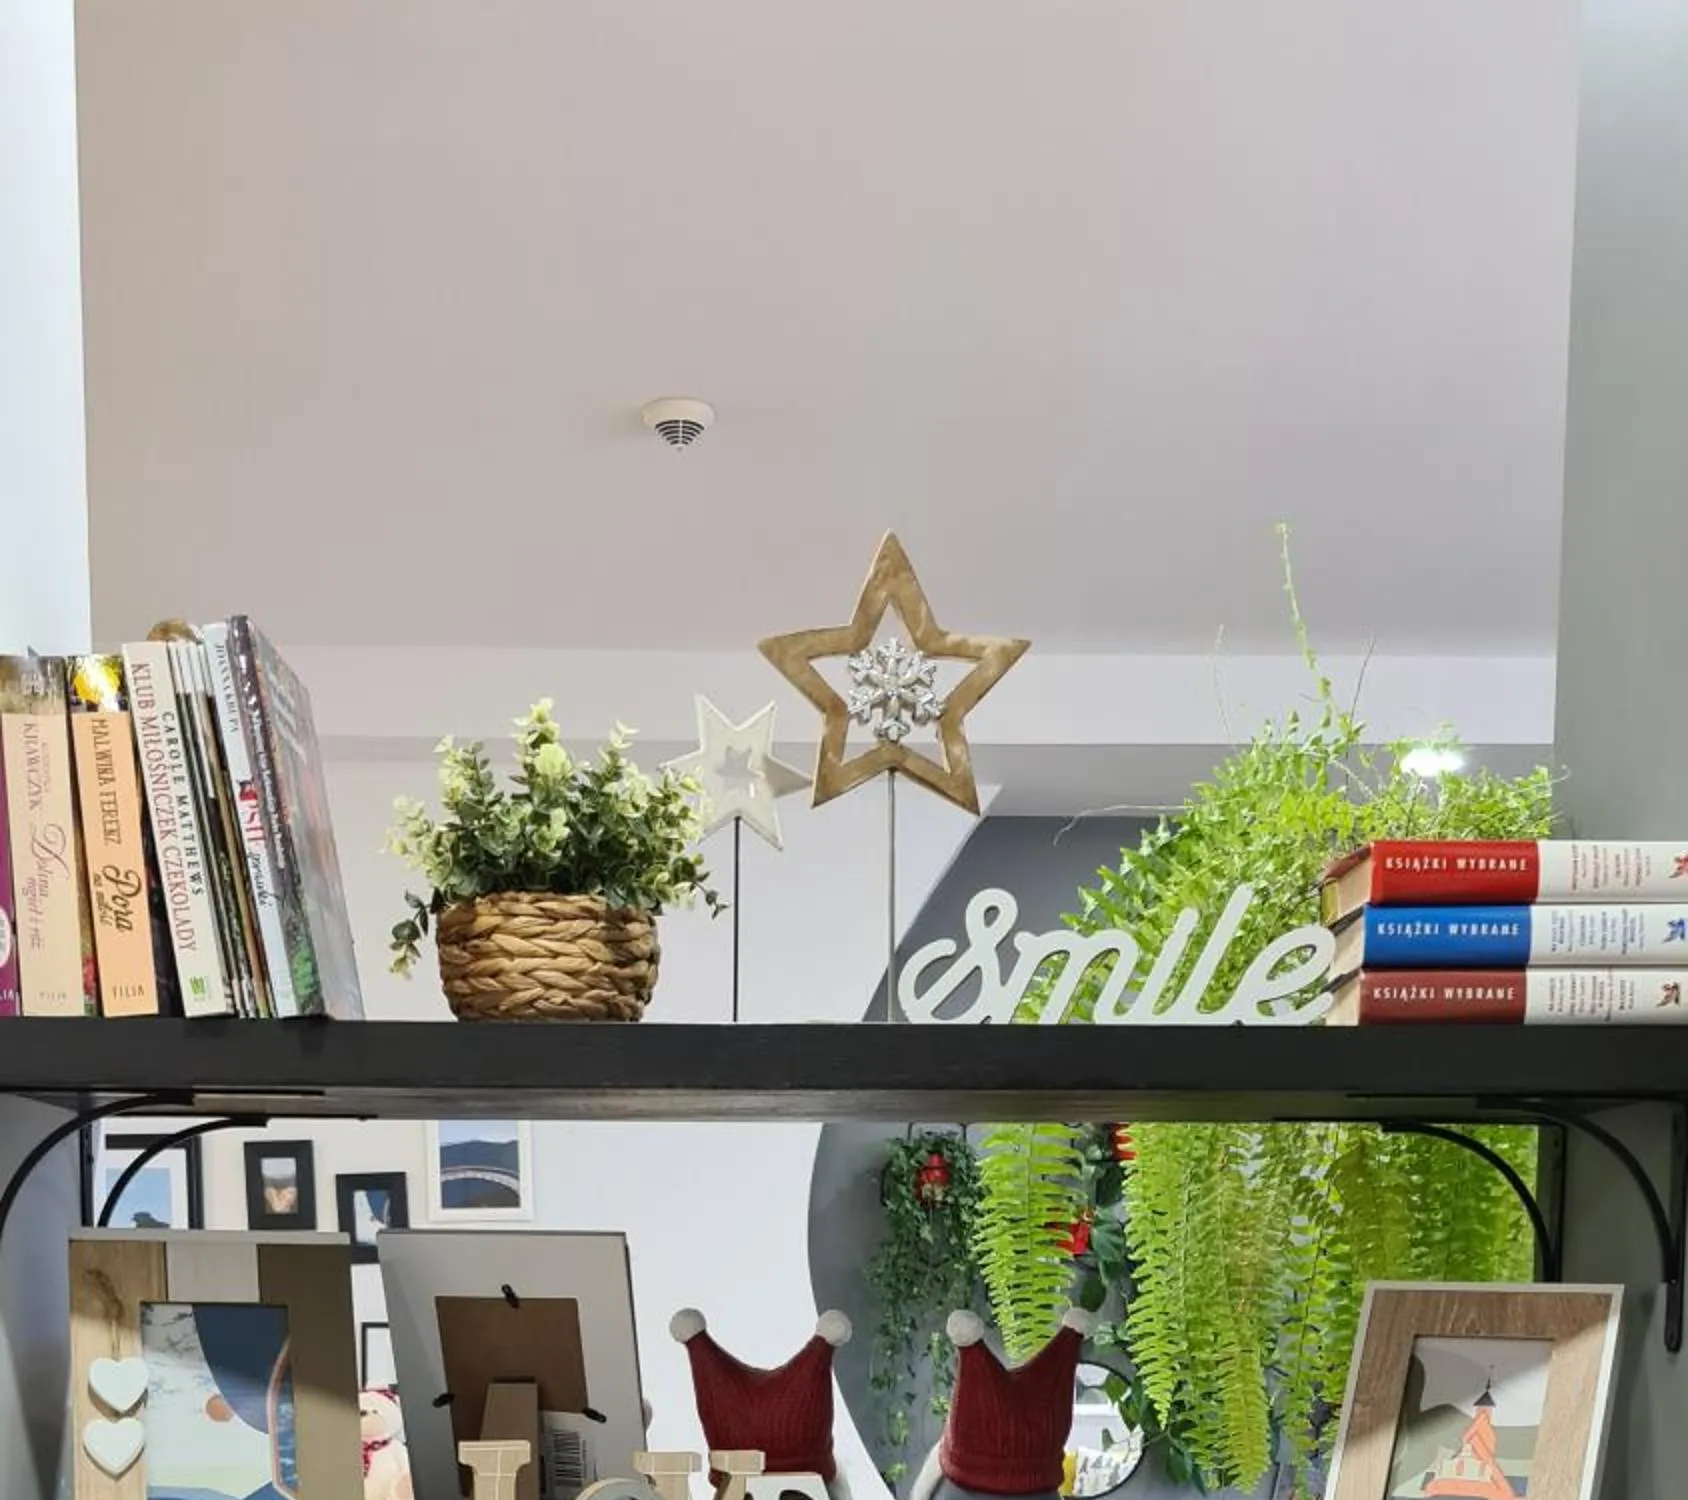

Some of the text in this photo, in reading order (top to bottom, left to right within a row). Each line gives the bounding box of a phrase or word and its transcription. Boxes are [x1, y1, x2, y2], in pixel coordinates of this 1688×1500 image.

[91, 718, 116, 787] MALWINA
[130, 662, 196, 952] KLUB MIŁOŚNICZEK CZEKOLADY
[161, 711, 204, 897] CAROLE MATTHEWS
[101, 864, 141, 933] Pora
[1385, 856, 1529, 873] KSIĄŻKI WYBRANE
[899, 886, 1336, 1025] Smile
[1377, 921, 1520, 939] KSIĄŻKI WYBRANE
[1373, 985, 1517, 1002] KSIĄŻKI WYBRANE
